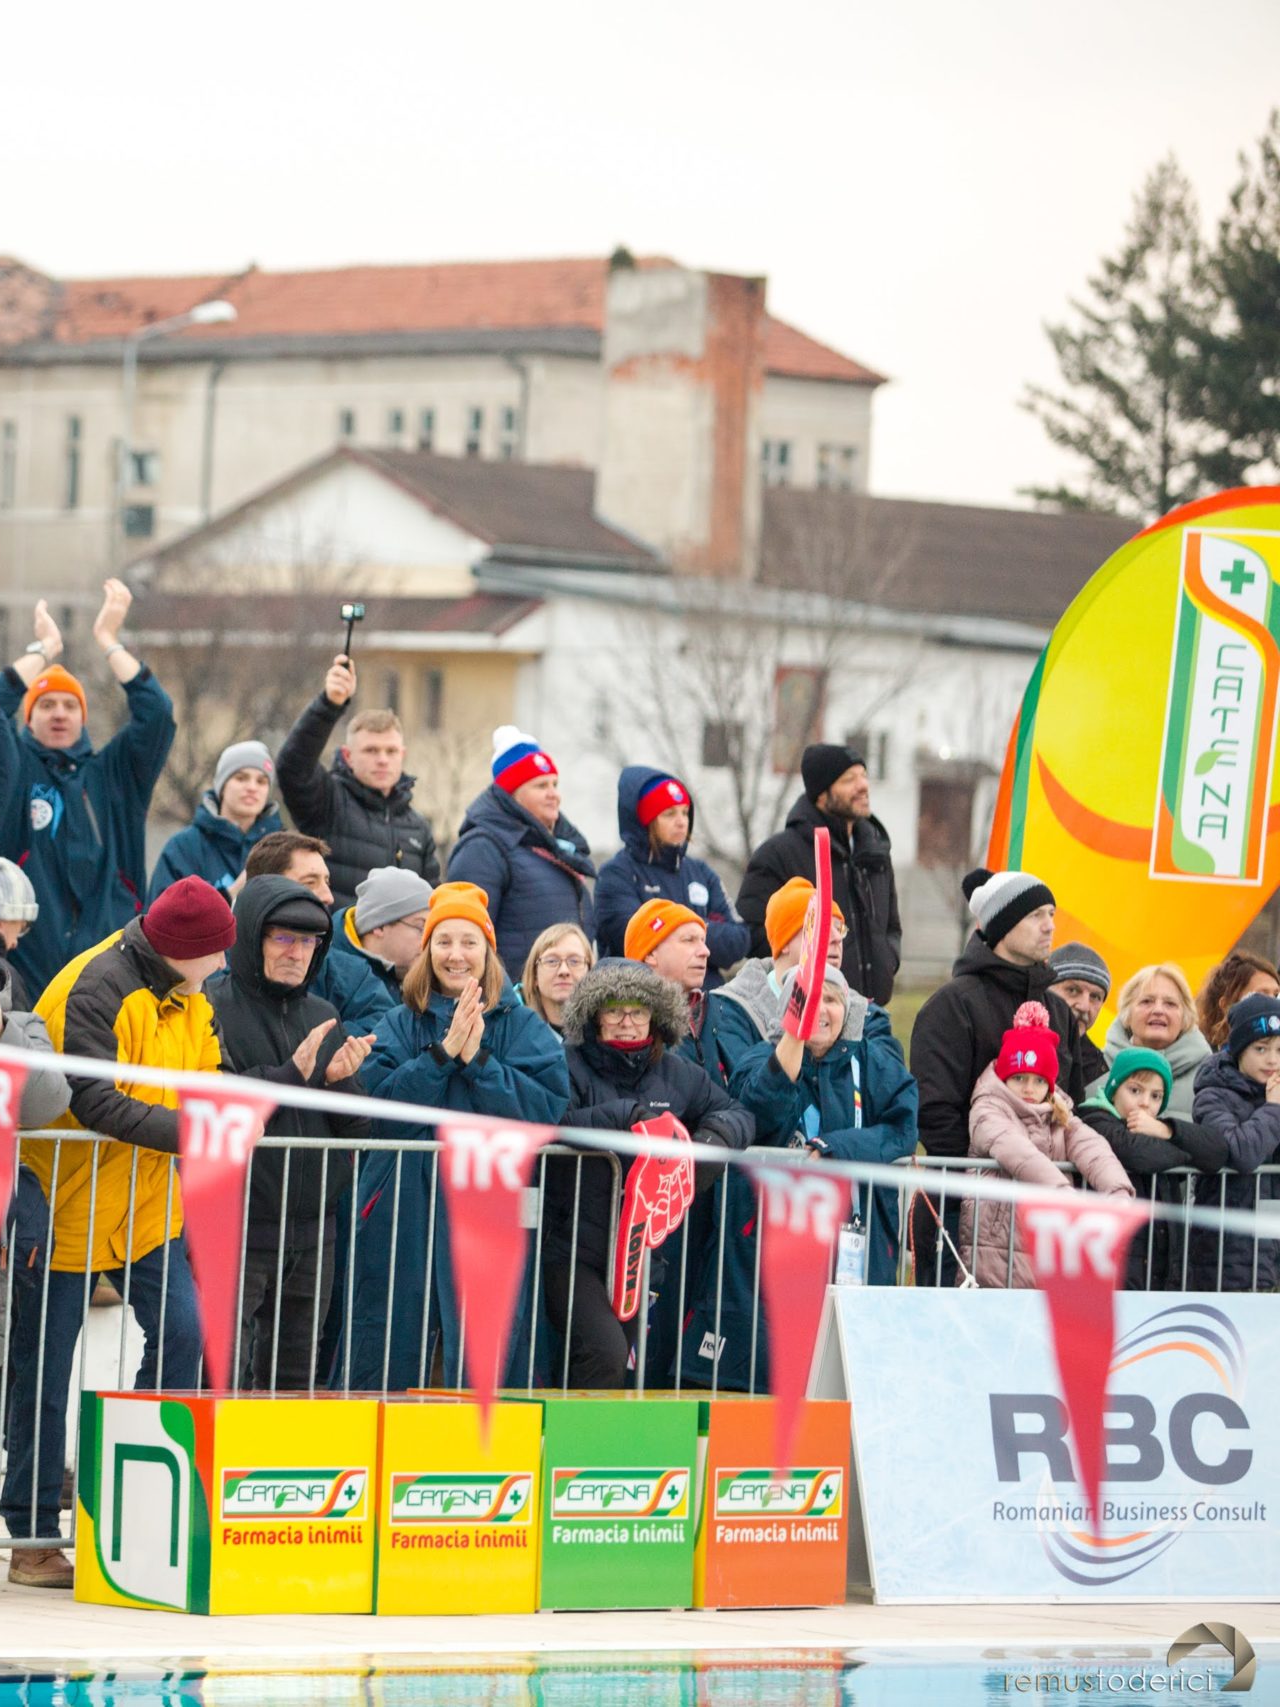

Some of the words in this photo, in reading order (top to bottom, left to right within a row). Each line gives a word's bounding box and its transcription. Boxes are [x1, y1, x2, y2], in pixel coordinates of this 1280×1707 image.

[1193, 643, 1247, 840] CATENA
[184, 1098, 254, 1164] TYR
[447, 1126, 530, 1191] TYR
[754, 1168, 839, 1242] TYR
[1027, 1210, 1117, 1278] TYR
[989, 1392, 1253, 1485] RBC
[236, 1484, 326, 1506] CATENA
[406, 1489, 492, 1510] CATENA
[567, 1484, 650, 1504] CATENA
[729, 1484, 806, 1503] CATENA
[1102, 1502, 1188, 1521] Business
[1193, 1501, 1267, 1521] Consult
[222, 1528, 303, 1545] Farmacia
[308, 1525, 363, 1544] inimii
[391, 1531, 470, 1548] Farmacia
[475, 1527, 528, 1548] inimii
[552, 1525, 629, 1544] Farmacia
[633, 1523, 685, 1543] inimii
[716, 1523, 787, 1543] Farmacia
[791, 1522, 839, 1542] inimii
